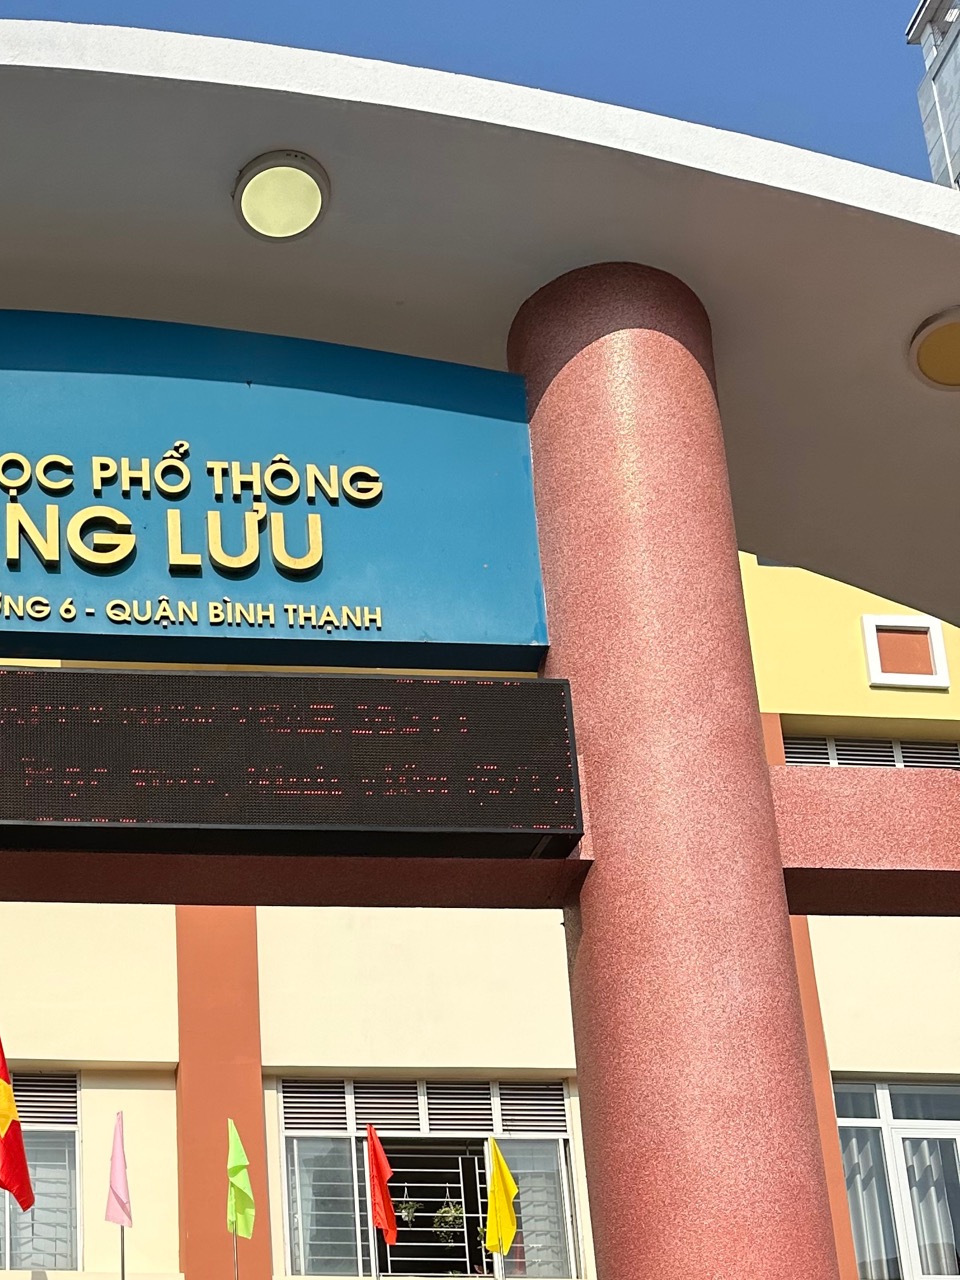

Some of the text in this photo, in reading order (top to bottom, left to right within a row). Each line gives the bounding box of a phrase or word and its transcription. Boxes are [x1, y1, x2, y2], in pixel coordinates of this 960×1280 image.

[91, 440, 192, 498] PHỔ
[206, 453, 384, 506] THÔNG
[166, 501, 324, 579] LƯU
[59, 597, 77, 621] 6
[105, 595, 199, 628] QUẬN
[209, 596, 275, 625] BÌNH
[284, 604, 383, 633] THẠNH
